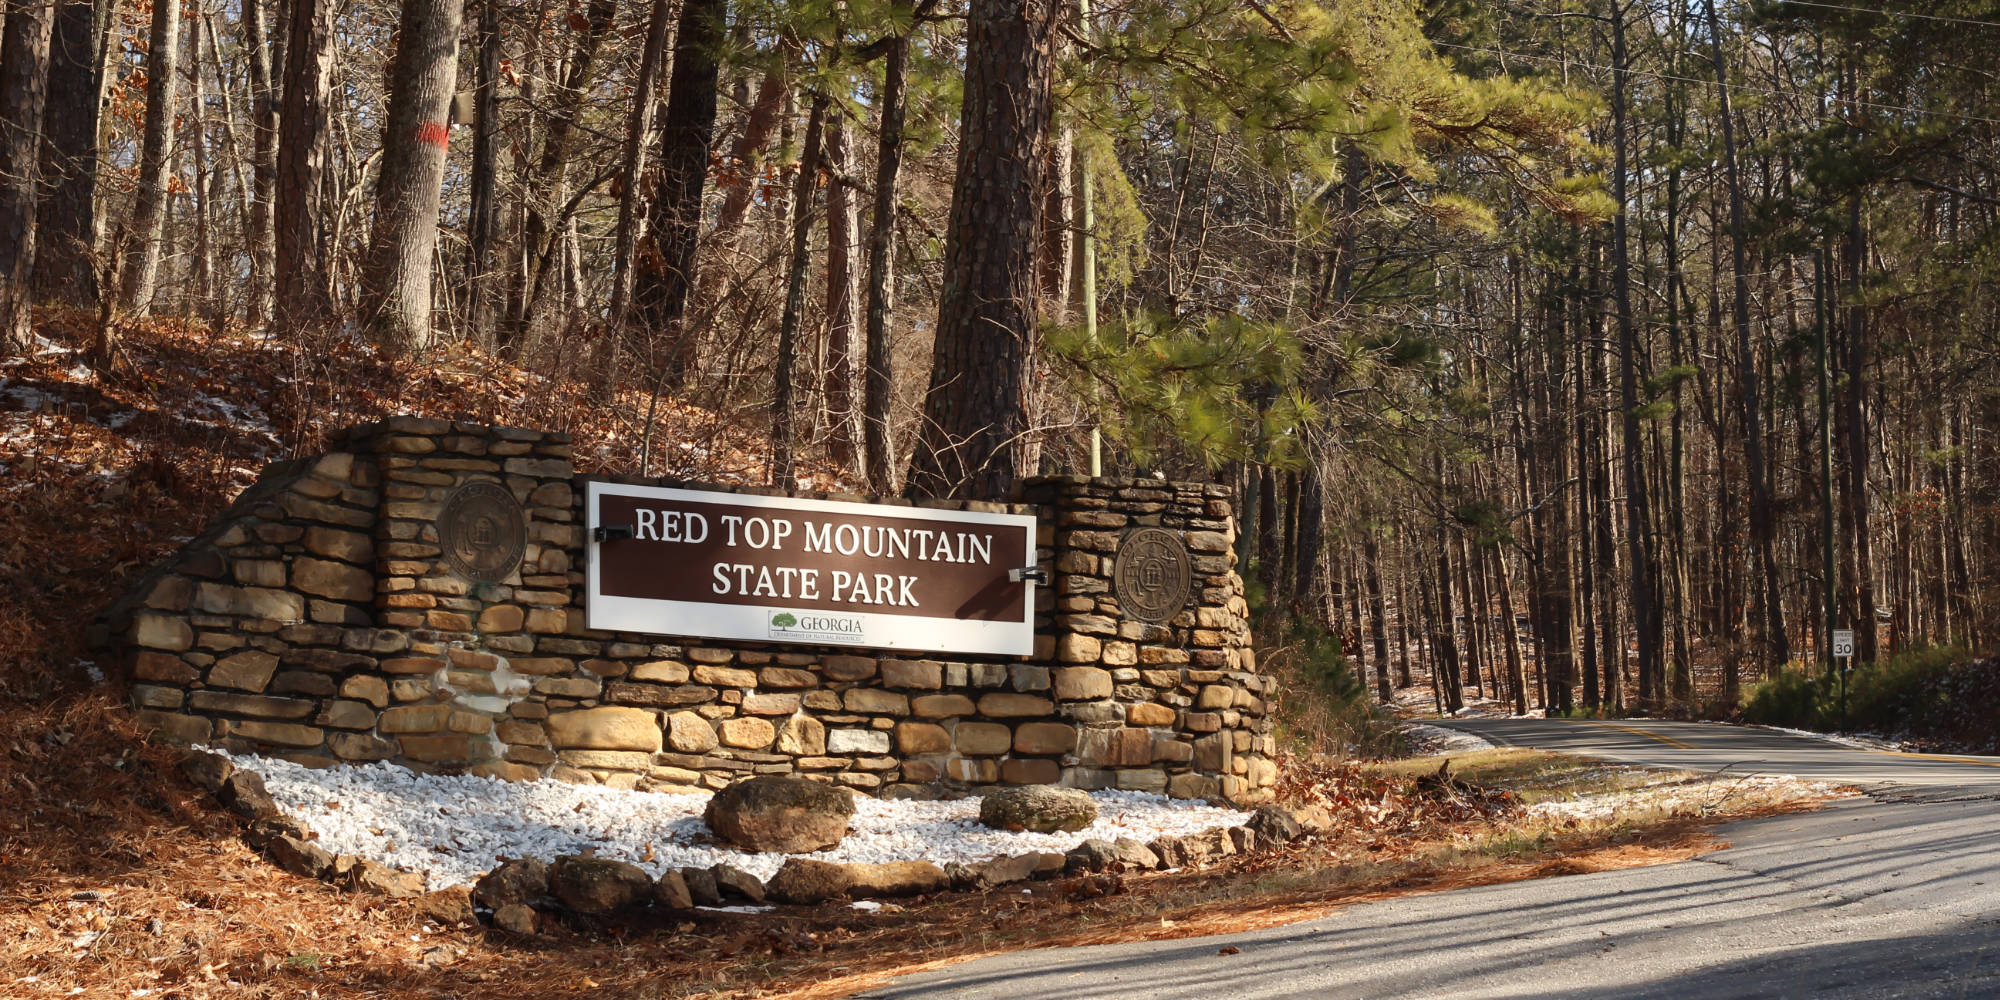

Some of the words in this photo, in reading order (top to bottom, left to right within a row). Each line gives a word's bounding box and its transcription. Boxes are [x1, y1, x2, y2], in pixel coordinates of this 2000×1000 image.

[635, 508, 709, 544] RED
[720, 515, 792, 550] TOP
[803, 521, 993, 565] MOUNTAIN
[712, 562, 820, 600] STATE
[831, 570, 920, 607] PARK
[801, 616, 862, 632] GEORGIA
[1835, 643, 1852, 654] 30
